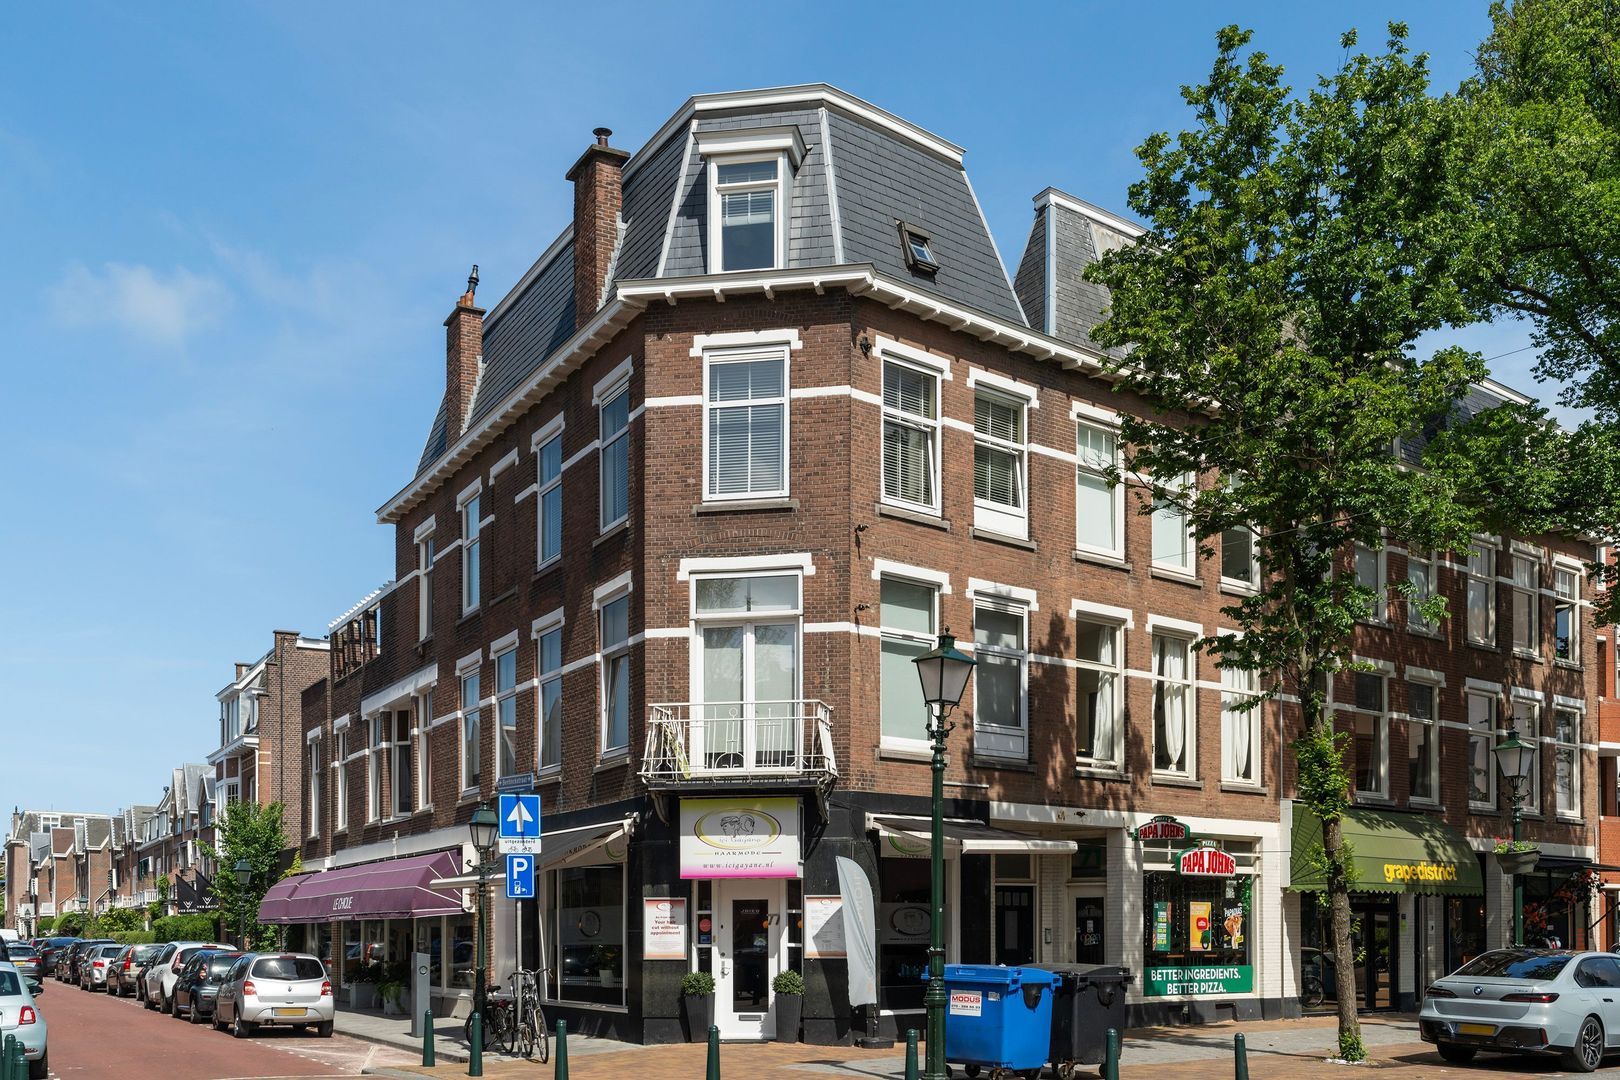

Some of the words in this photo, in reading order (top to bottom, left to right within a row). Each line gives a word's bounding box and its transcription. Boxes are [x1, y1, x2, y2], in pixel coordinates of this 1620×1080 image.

[1139, 823, 1158, 838] PAPA
[1160, 823, 1185, 838] JOHNS
[513, 857, 528, 879] P
[703, 861, 774, 870] www.icigayane.nl
[1181, 850, 1205, 873] PAPA
[1206, 850, 1235, 874] JOHNS
[1384, 861, 1457, 883] grapedistrict
[1151, 969, 1183, 981] BETTER
[1184, 968, 1241, 980] INGREDIENTS.
[1167, 983, 1199, 994] BETTER
[1201, 982, 1226, 993] PIZZA.
[952, 995, 981, 1003] MODUS
